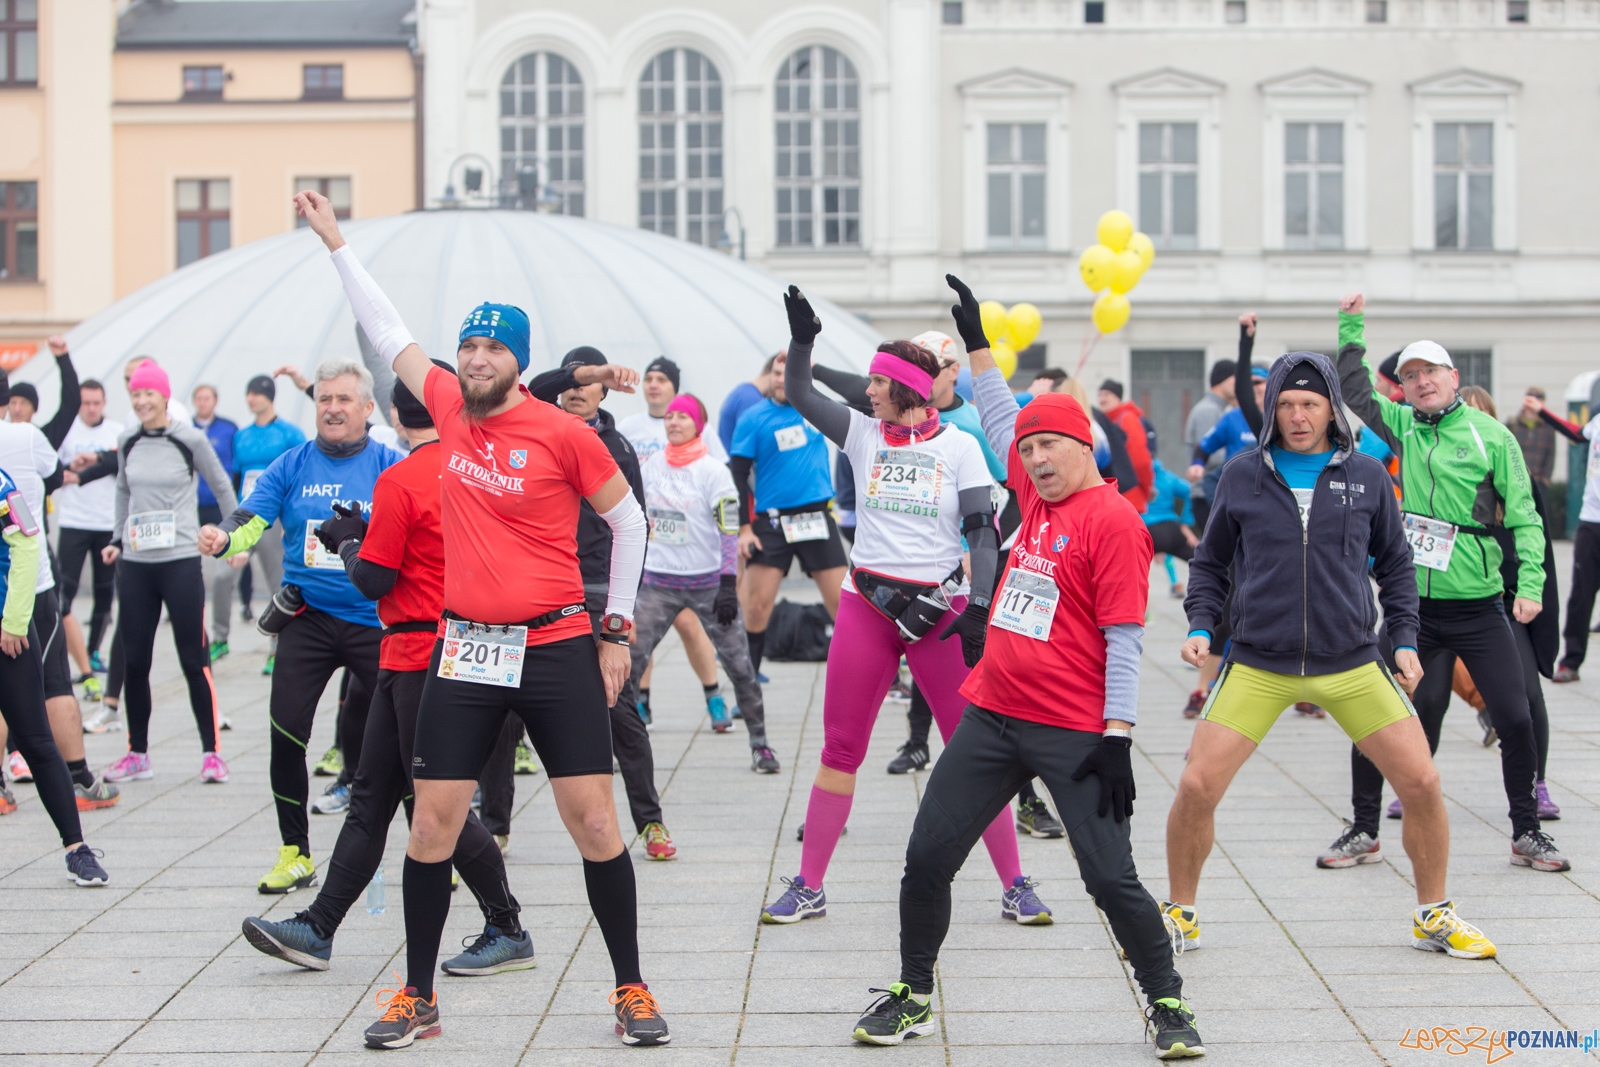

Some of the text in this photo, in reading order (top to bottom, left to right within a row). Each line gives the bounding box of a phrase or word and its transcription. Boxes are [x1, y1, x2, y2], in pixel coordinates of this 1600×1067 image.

[881, 465, 917, 485] 234
[1505, 435, 1528, 489] RUNNERS
[1521, 495, 1539, 524] TEAM
[302, 484, 343, 498] HART
[865, 497, 939, 518] 23.10.2016
[137, 523, 161, 539] 388
[655, 519, 676, 533] 260
[1407, 531, 1435, 552] 143
[1003, 589, 1034, 615] 117
[1001, 611, 1021, 623] Tadeusz
[459, 641, 501, 667] 201
[471, 665, 487, 674] Piotr
